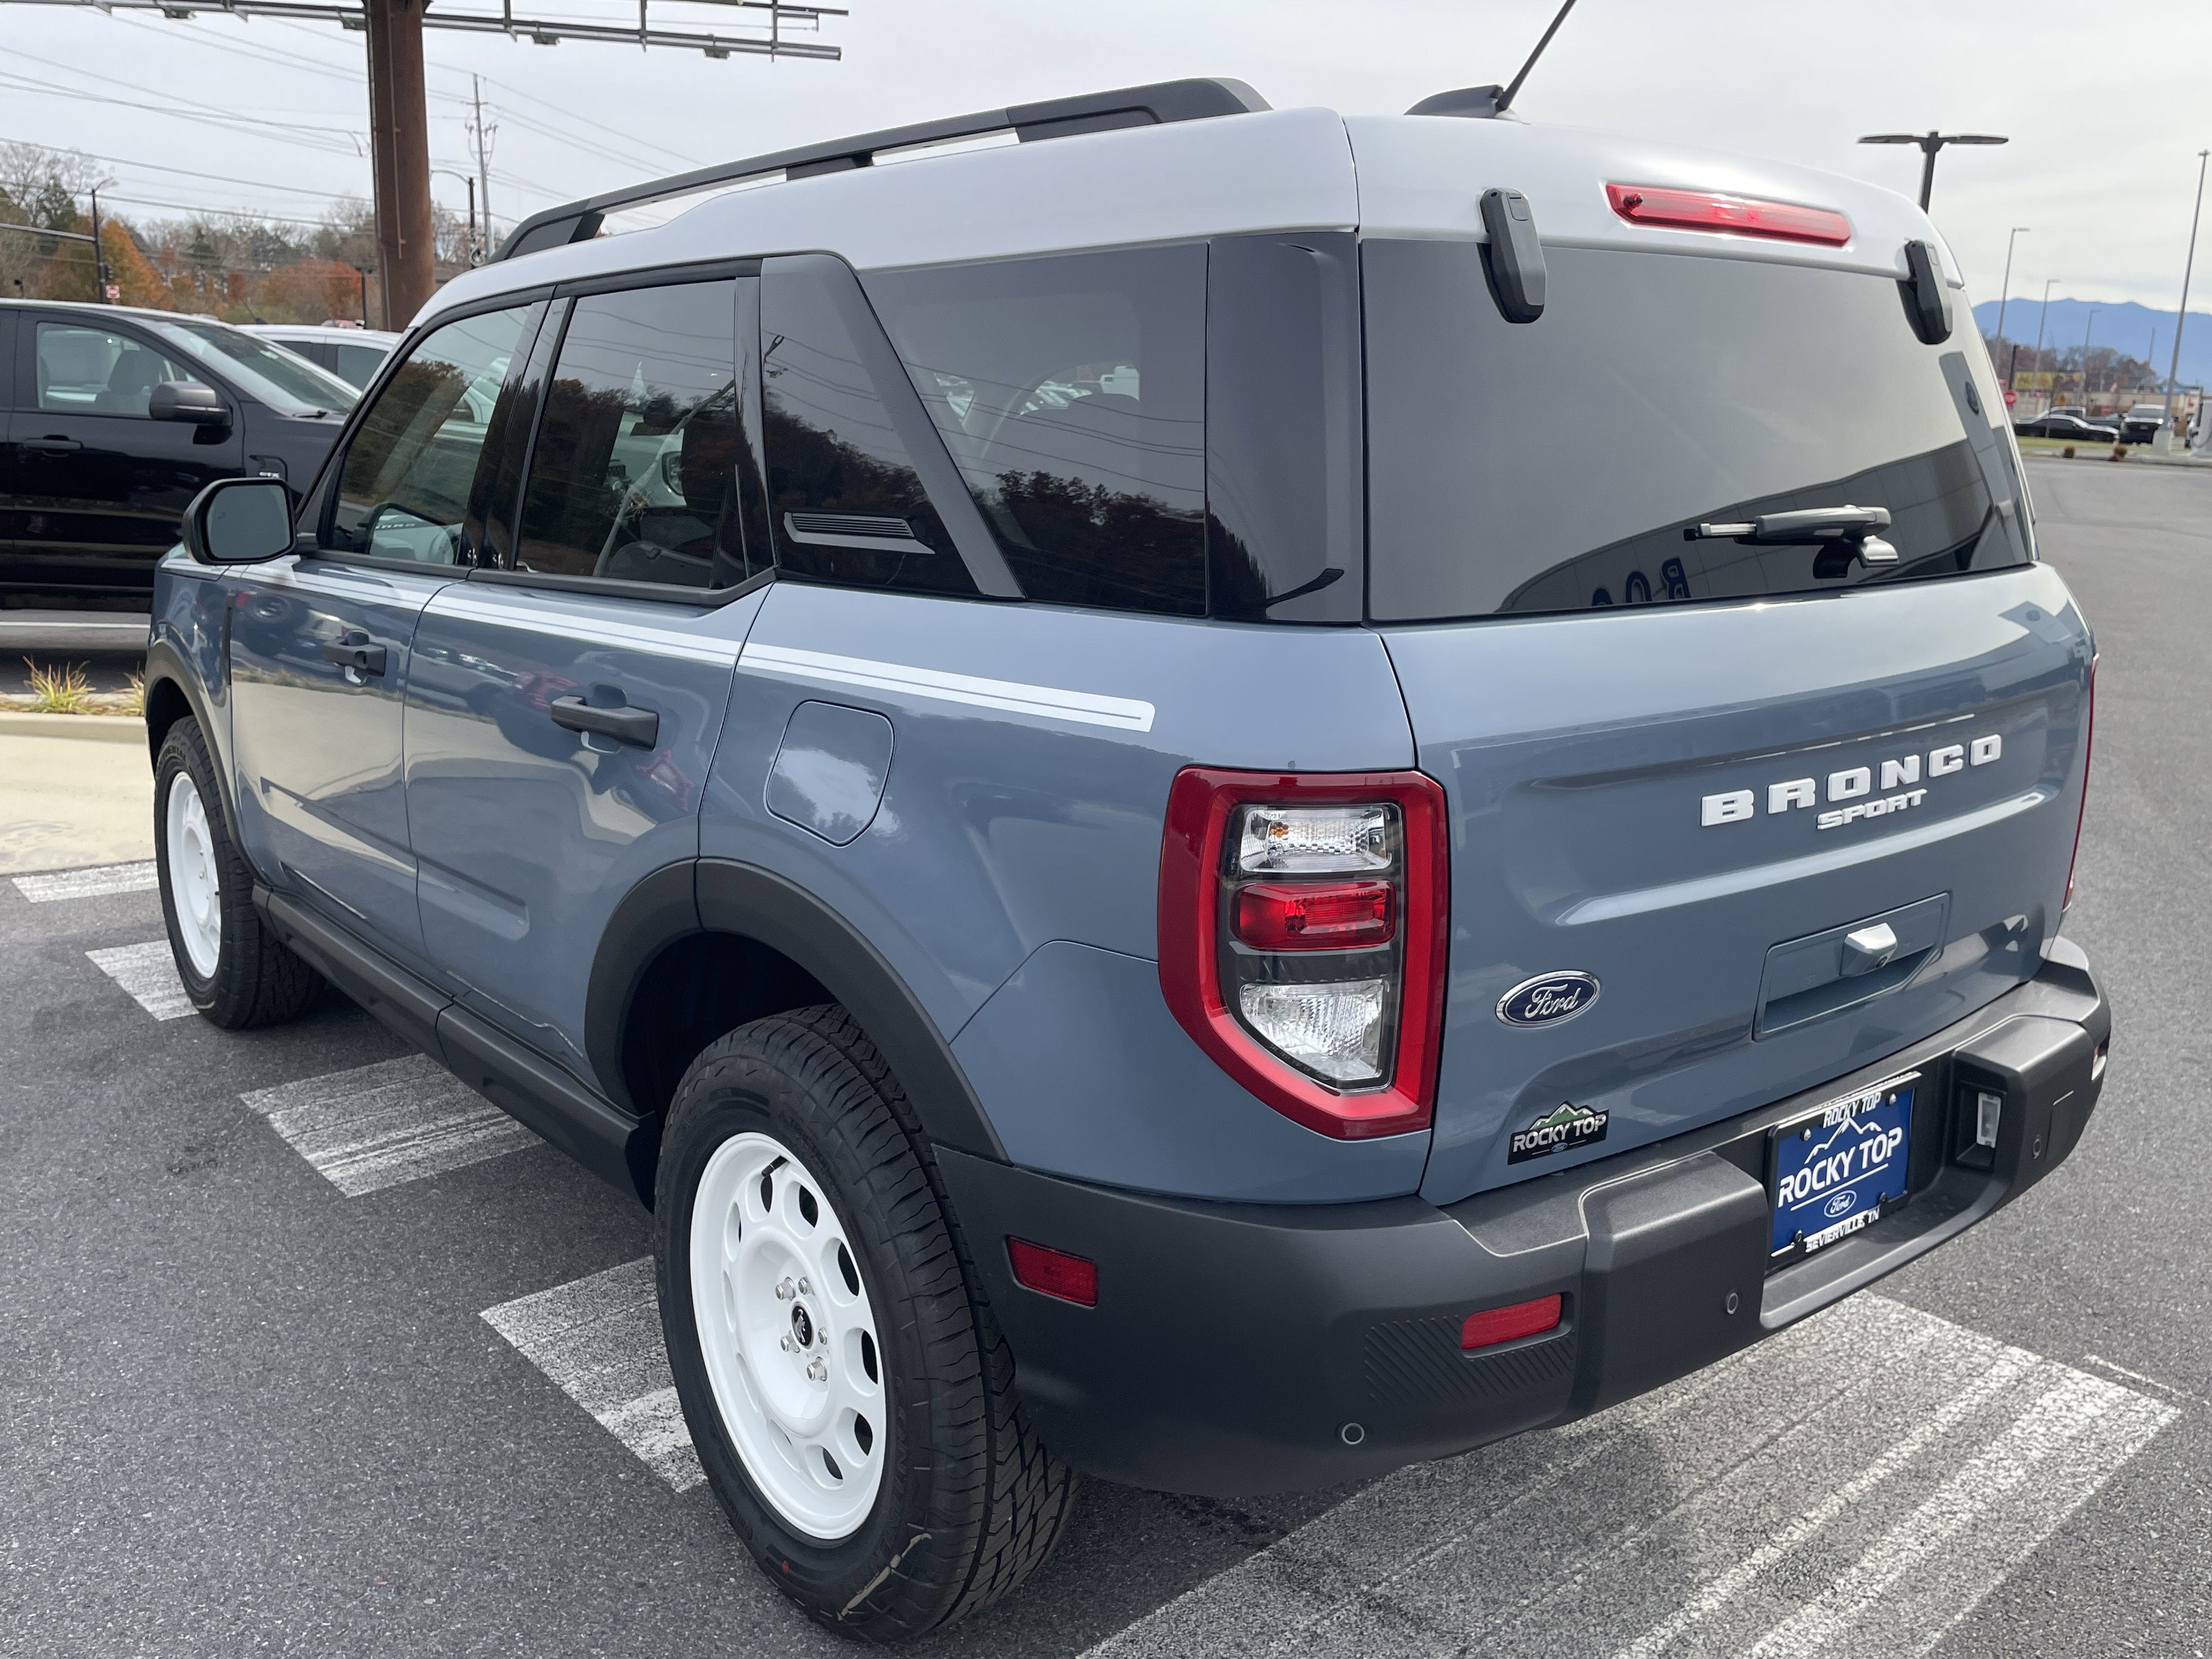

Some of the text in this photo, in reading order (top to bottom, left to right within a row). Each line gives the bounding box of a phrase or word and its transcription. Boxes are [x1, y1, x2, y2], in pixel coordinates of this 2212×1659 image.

[1701, 734, 2001, 826] BRONCO
[1817, 789, 1927, 830] SPORT
[1524, 984, 1581, 1018] Ford
[1822, 1092, 1882, 1128] ROCKY TOP
[1513, 1114, 1606, 1152] ROCKY TOP
[1778, 1126, 1903, 1208] ROCKY TOP
